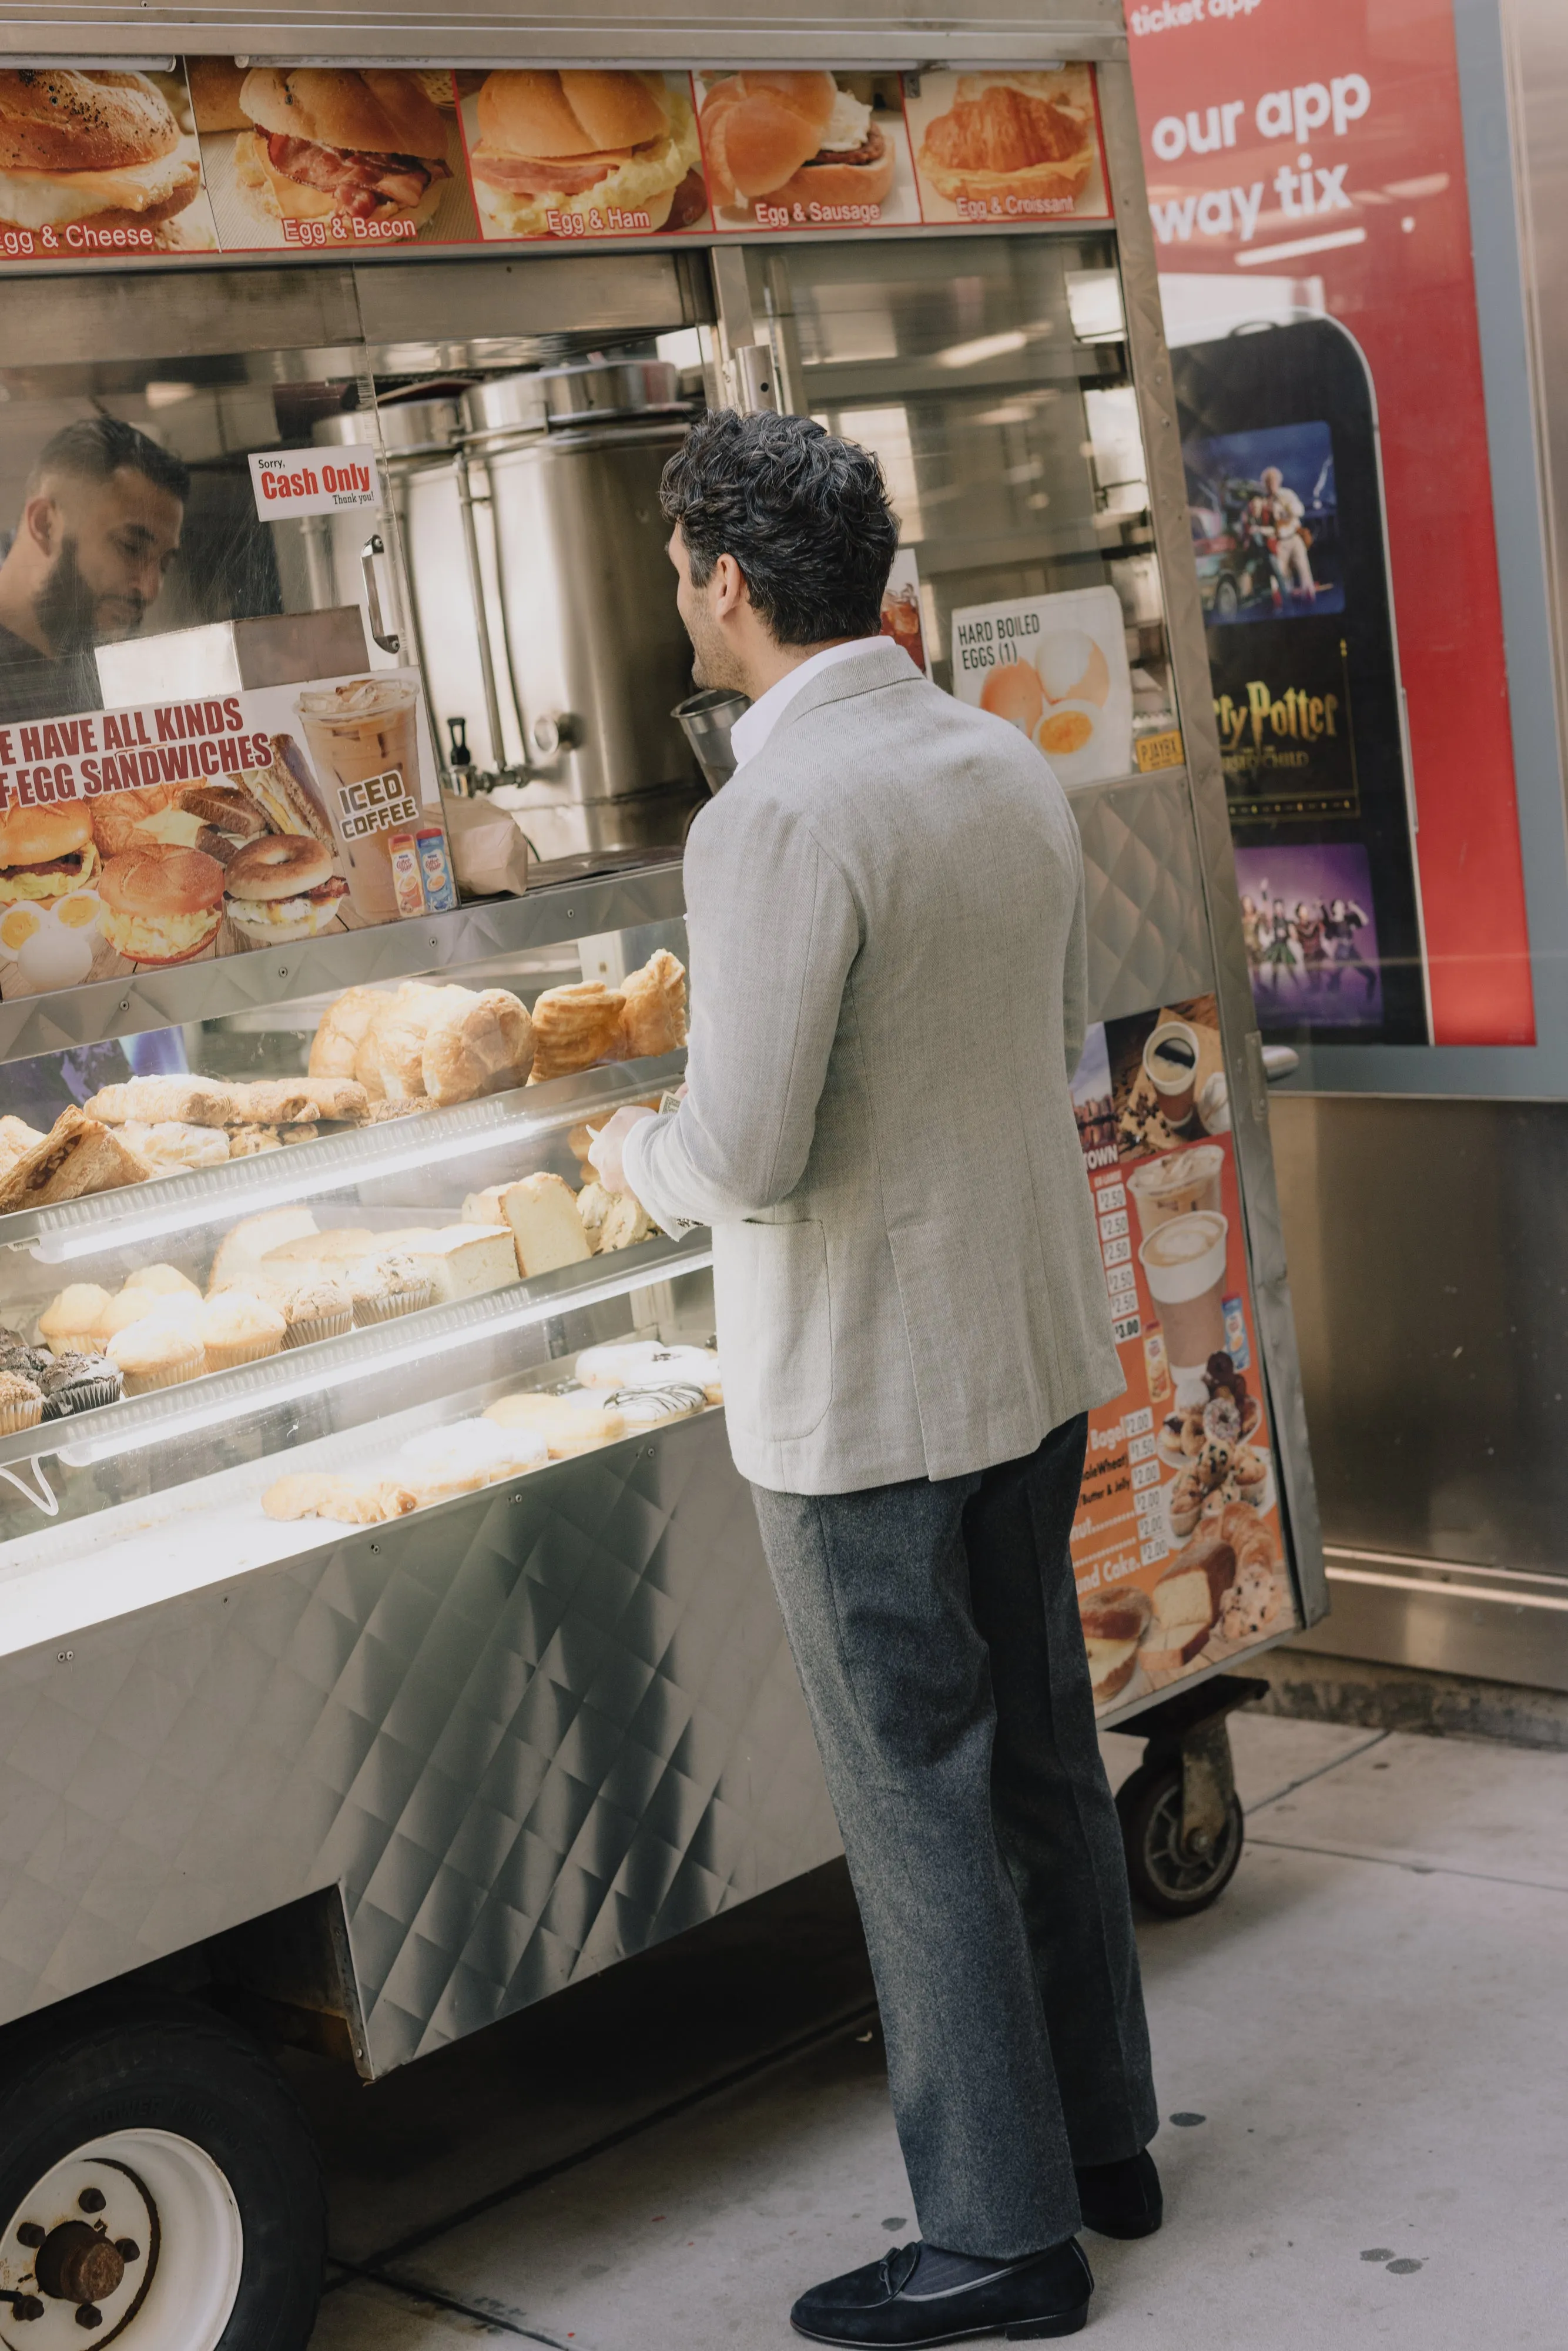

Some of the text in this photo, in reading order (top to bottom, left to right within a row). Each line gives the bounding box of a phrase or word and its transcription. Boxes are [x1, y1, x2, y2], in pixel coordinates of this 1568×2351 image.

[1130, 0, 1205, 36] ticket
[1151, 73, 1371, 160] our app
[755, 202, 880, 226] Egg & Sausage
[956, 195, 1074, 219] Egg & Croissant
[1149, 153, 1352, 245] way tix
[283, 217, 416, 244] Egg & Bacon
[547, 208, 650, 235] Egg & Ham
[0, 225, 153, 254] gg & Cheese
[259, 459, 285, 469] Sorry,
[261, 463, 370, 499] Cash Only
[333, 491, 374, 505] Thank you!
[958, 614, 1040, 645] HARD BOILED
[962, 640, 1017, 669] EGGS (1)
[19, 719, 98, 762] HAVE
[103, 711, 152, 751] ALL
[154, 698, 243, 742] KINDS
[1245, 681, 1338, 750] Potter
[16, 763, 76, 805] EGG
[81, 732, 272, 795] SANDWICHES
[339, 773, 403, 814] ICED
[341, 799, 416, 838] COFFEE
[1090, 1416, 1126, 1451] Bagel
